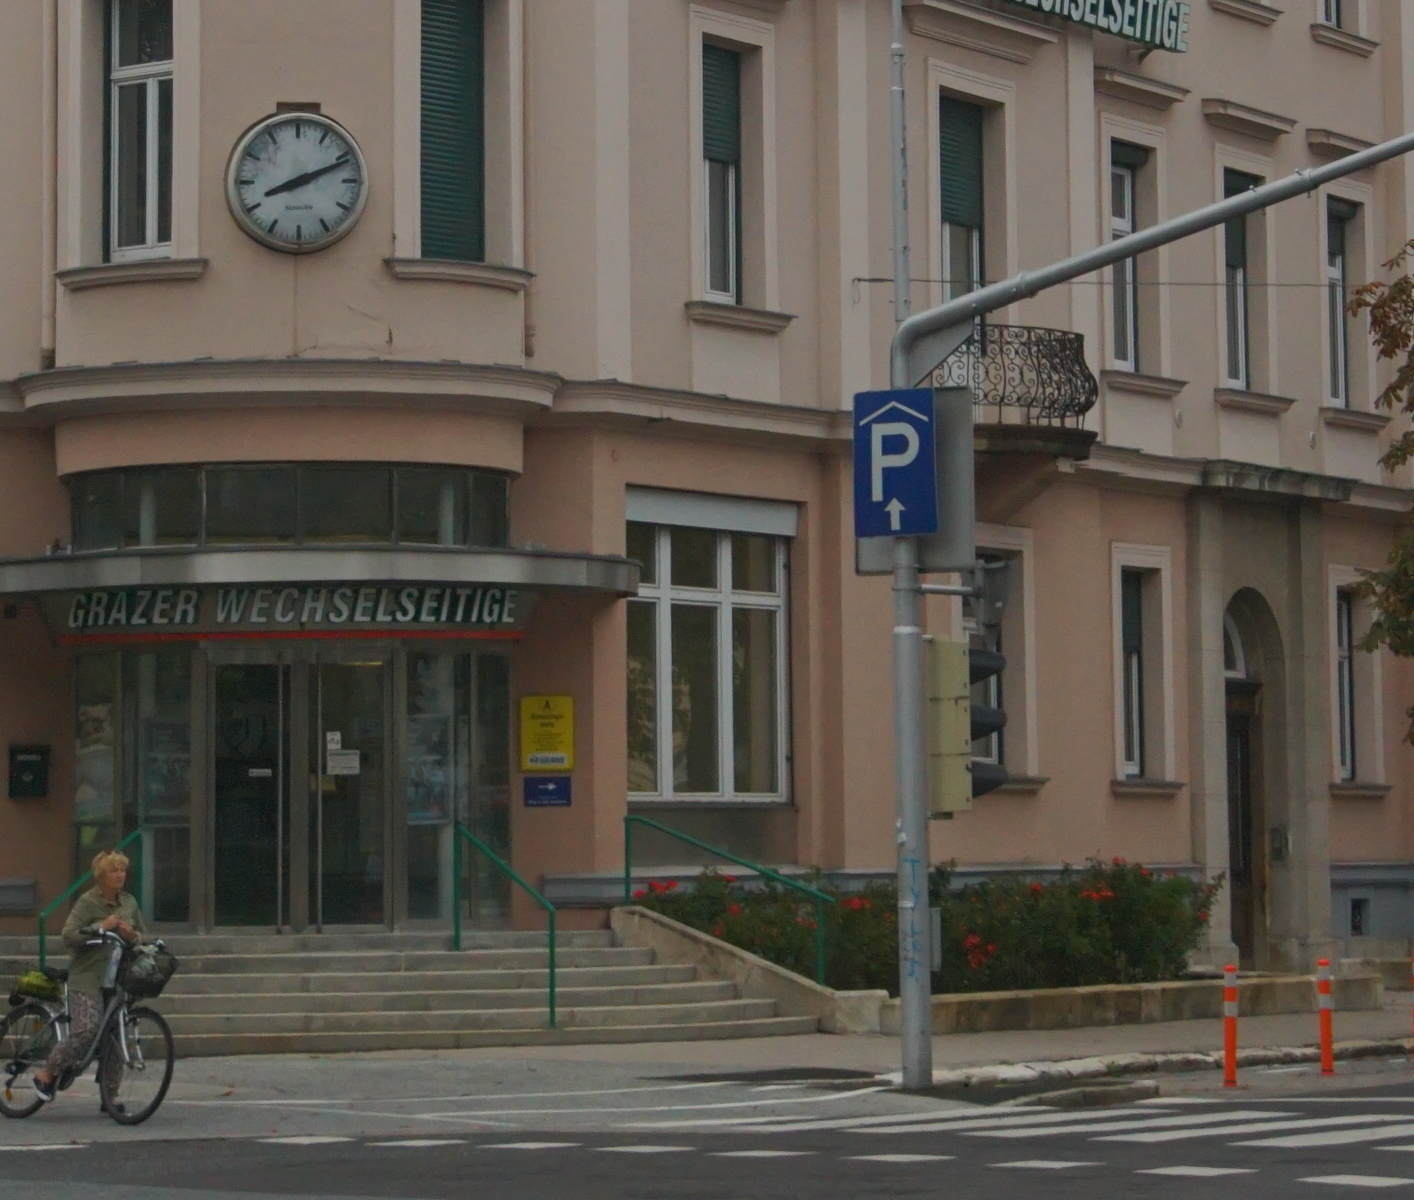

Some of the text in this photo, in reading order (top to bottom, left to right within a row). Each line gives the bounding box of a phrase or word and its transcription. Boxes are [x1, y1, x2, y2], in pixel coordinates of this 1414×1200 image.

[871, 422, 919, 502] P
[68, 587, 515, 629] GRAZER WECHSELSEITIGE
